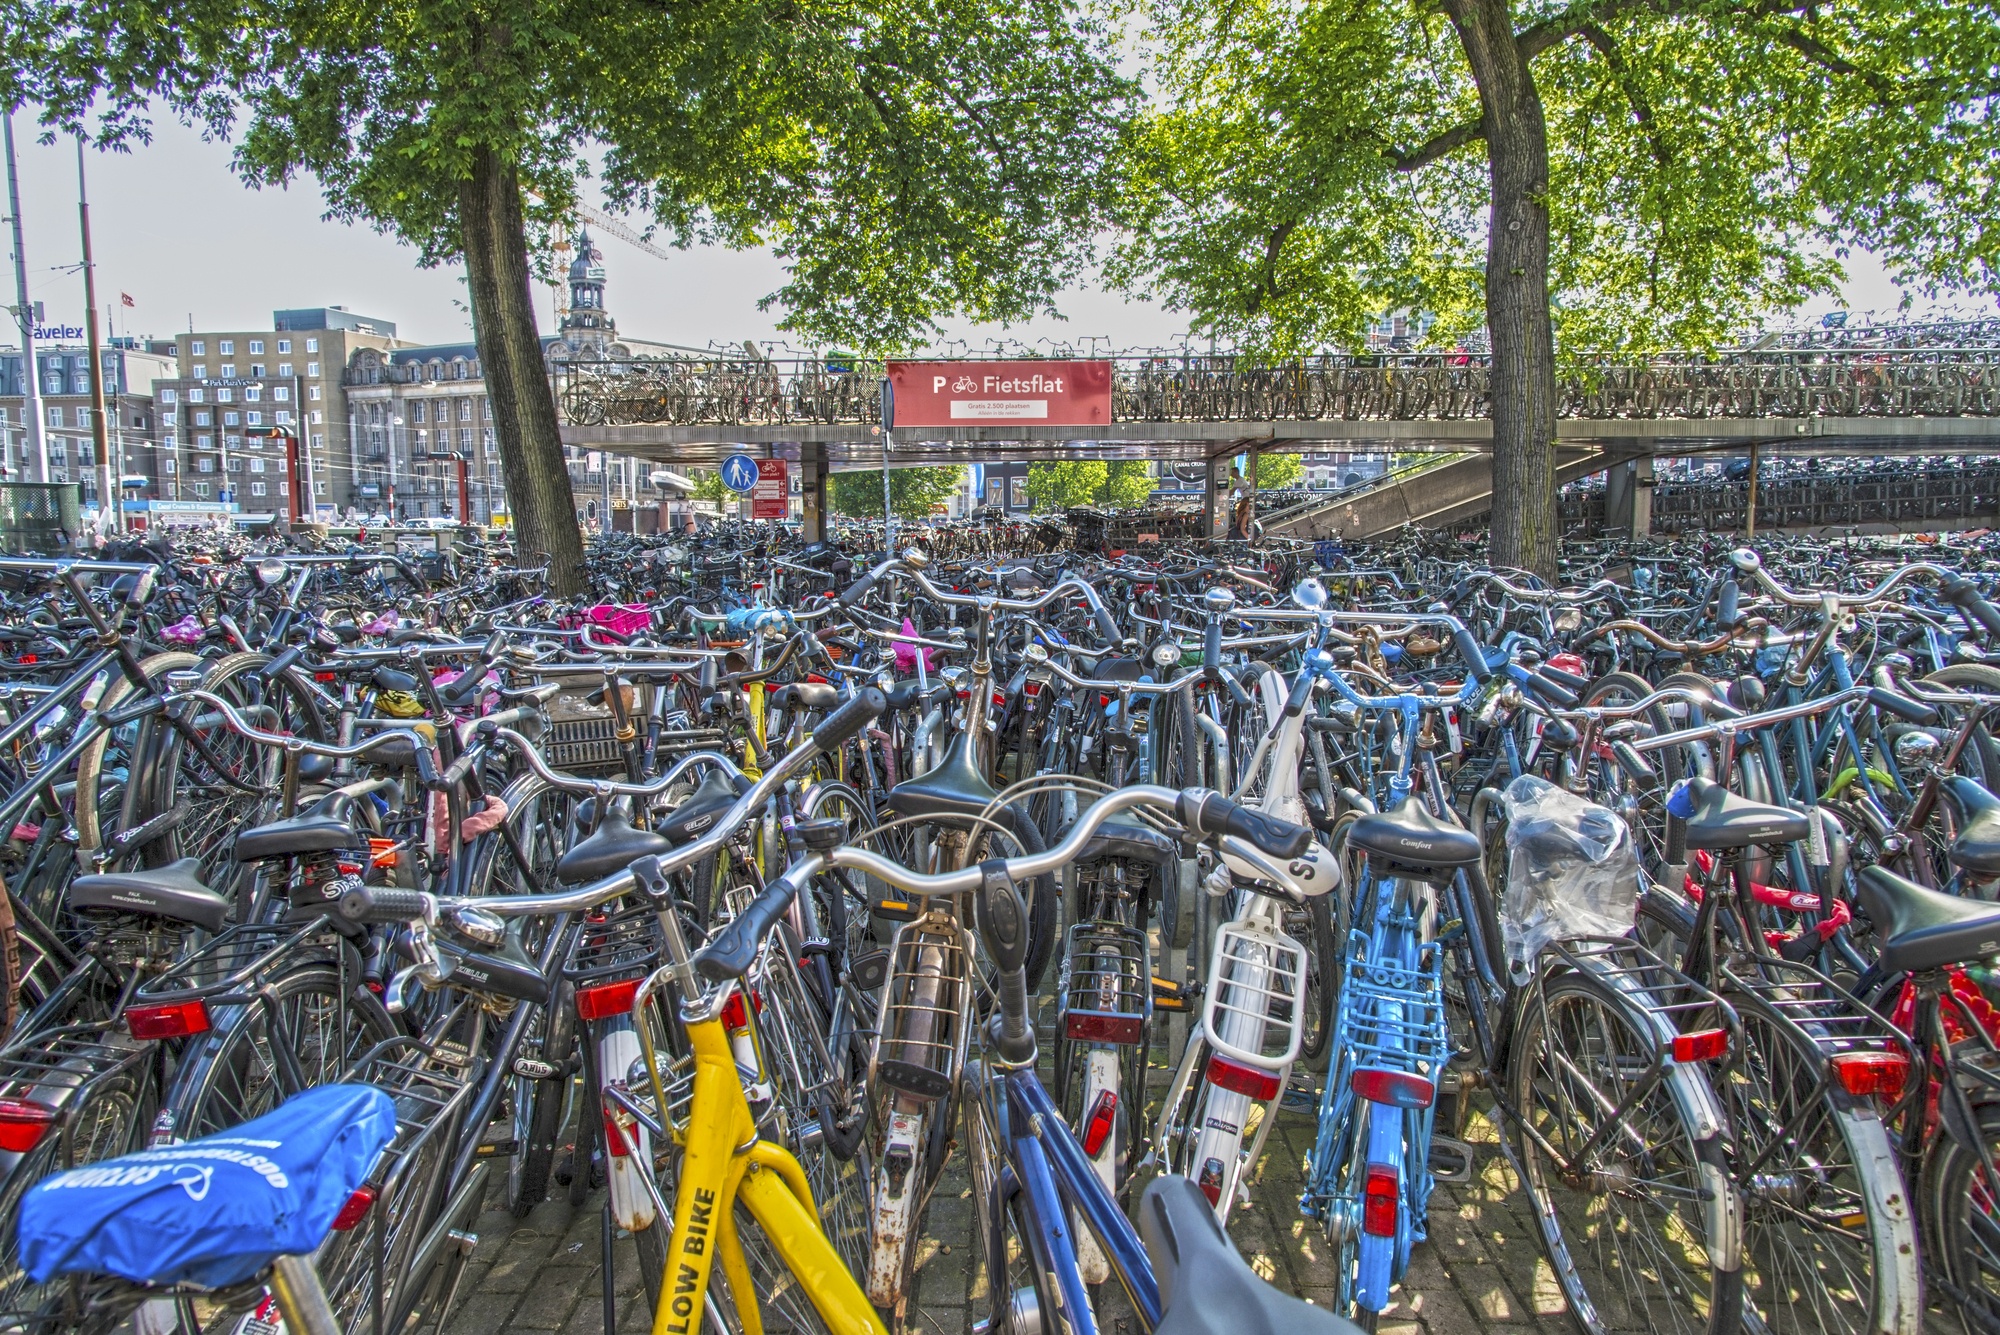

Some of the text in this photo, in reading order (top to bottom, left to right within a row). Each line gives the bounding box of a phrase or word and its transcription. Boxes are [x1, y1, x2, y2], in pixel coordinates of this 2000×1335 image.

[933, 374, 1064, 394] P Fietsflat
[1005, 403, 1031, 411] plaatsen
[1400, 838, 1432, 849] Comfort
[111, 894, 156, 906] www.cycletech.nl
[520, 1062, 548, 1075] ABUS
[1398, 1096, 1429, 1105] MULTICYCLE
[667, 1187, 716, 1334] LOW BIKE
